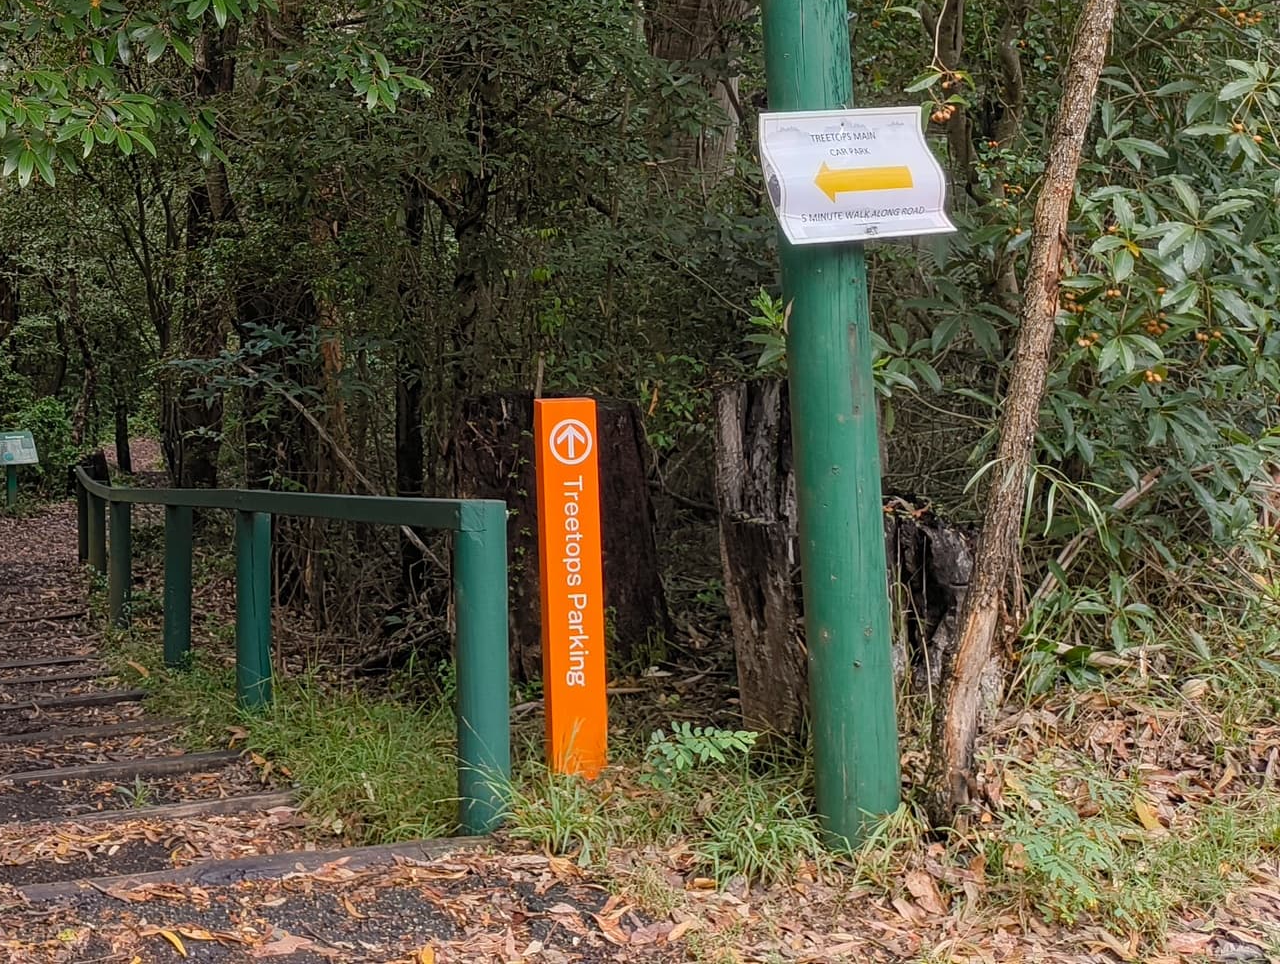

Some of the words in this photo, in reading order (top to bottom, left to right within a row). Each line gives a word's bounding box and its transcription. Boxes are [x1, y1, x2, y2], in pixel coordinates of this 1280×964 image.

[810, 132, 852, 143] TREETOPS
[853, 131, 876, 141] MAIN
[829, 147, 848, 157] CAR
[848, 146, 871, 156] PARK
[808, 211, 843, 223] MINUTE
[844, 208, 871, 220] WALK
[871, 206, 901, 218] ALONG
[901, 205, 925, 216] ROAD
[562, 475, 584, 587] Treetops
[565, 592, 590, 687] Parking
